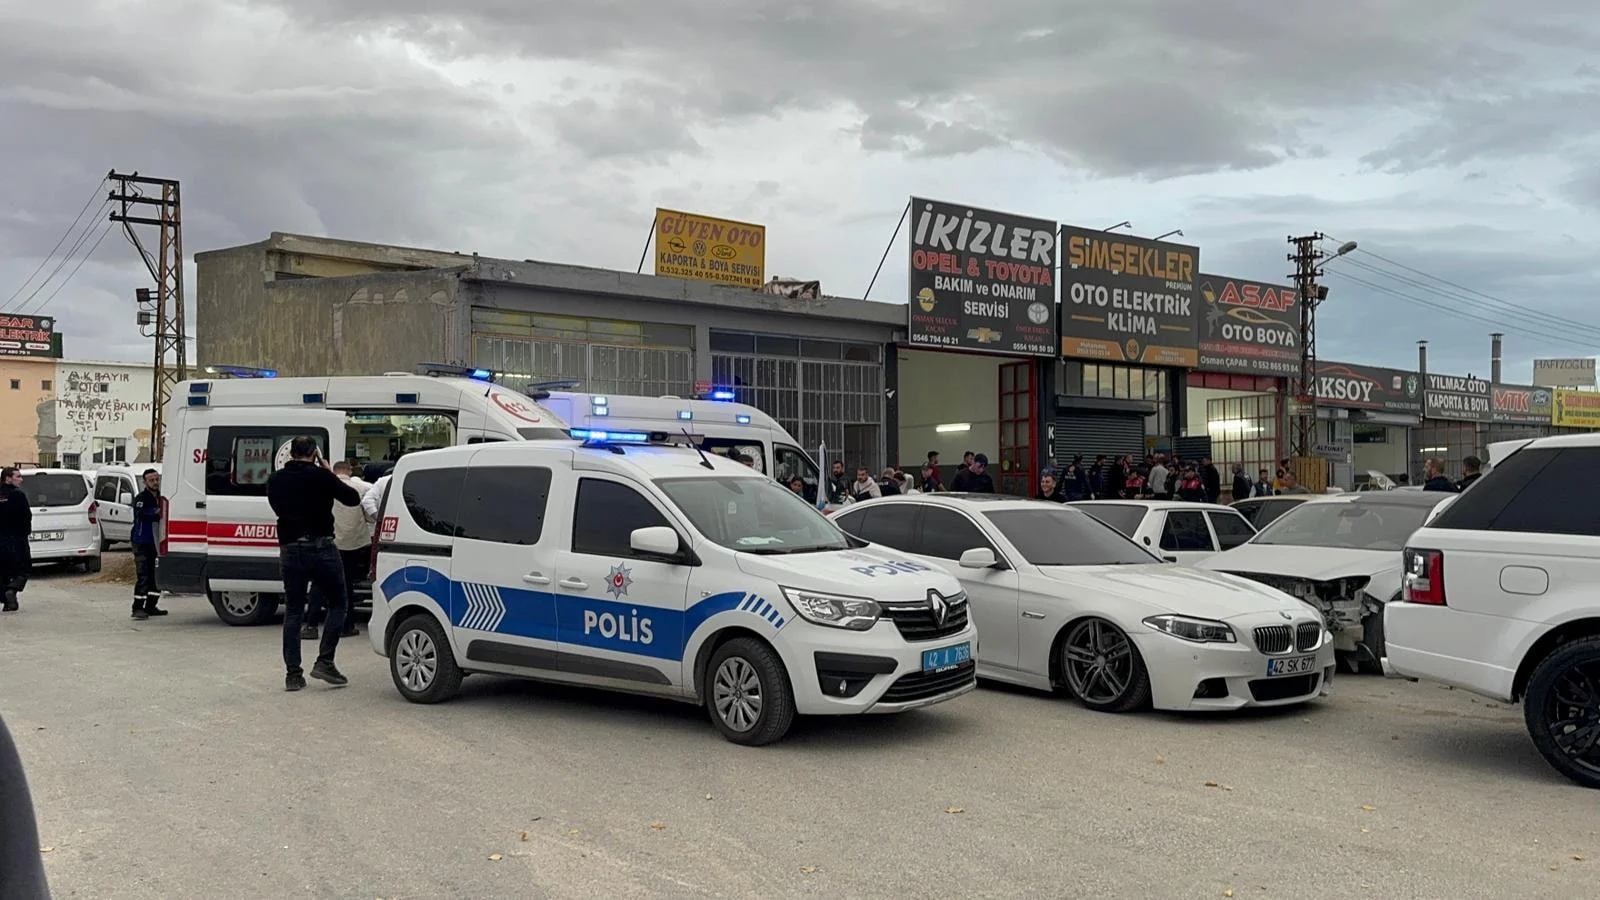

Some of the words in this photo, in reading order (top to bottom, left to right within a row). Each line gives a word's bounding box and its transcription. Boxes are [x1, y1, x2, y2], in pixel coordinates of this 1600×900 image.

[661, 213, 723, 241] GÜVEN
[727, 227, 761, 247] OTO
[914, 203, 1054, 266] İKİZLER
[660, 251, 698, 268] KAPORTA
[700, 259, 706, 269] &
[709, 260, 729, 274] BOYA
[912, 249, 962, 275] OPEL
[967, 257, 980, 278] &
[985, 259, 1053, 286] TOYOTA
[1069, 235, 1193, 282] ŞİMŞEKLER
[934, 275, 973, 294] BAKIM
[975, 284, 989, 295] ve
[991, 283, 1036, 300] ONARIM
[1070, 282, 1109, 307] OTO
[1112, 288, 1191, 316] ELEKTRİK
[1218, 281, 1297, 312] ASAF
[963, 300, 1009, 319] SERVİSİ
[1107, 311, 1157, 335] KLİMA
[1222, 323, 1254, 341] OTO
[1256, 327, 1295, 347] BOYA
[1200, 356, 1224, 365] Osman
[1430, 376, 1465, 392] YILMAZ
[1468, 381, 1486, 394] OTO
[1428, 393, 1463, 409] KAPORTA
[1464, 398, 1470, 410] &
[1471, 399, 1489, 412] BOYA
[1494, 390, 1529, 412] MTK
[384, 519, 396, 531] 112
[584, 608, 654, 645] POLİS
[929, 652, 938, 667] 42
[944, 649, 949, 665] A
[1273, 661, 1284, 673] 42
[1287, 660, 1299, 672] SK
[1301, 657, 1316, 671] 677
